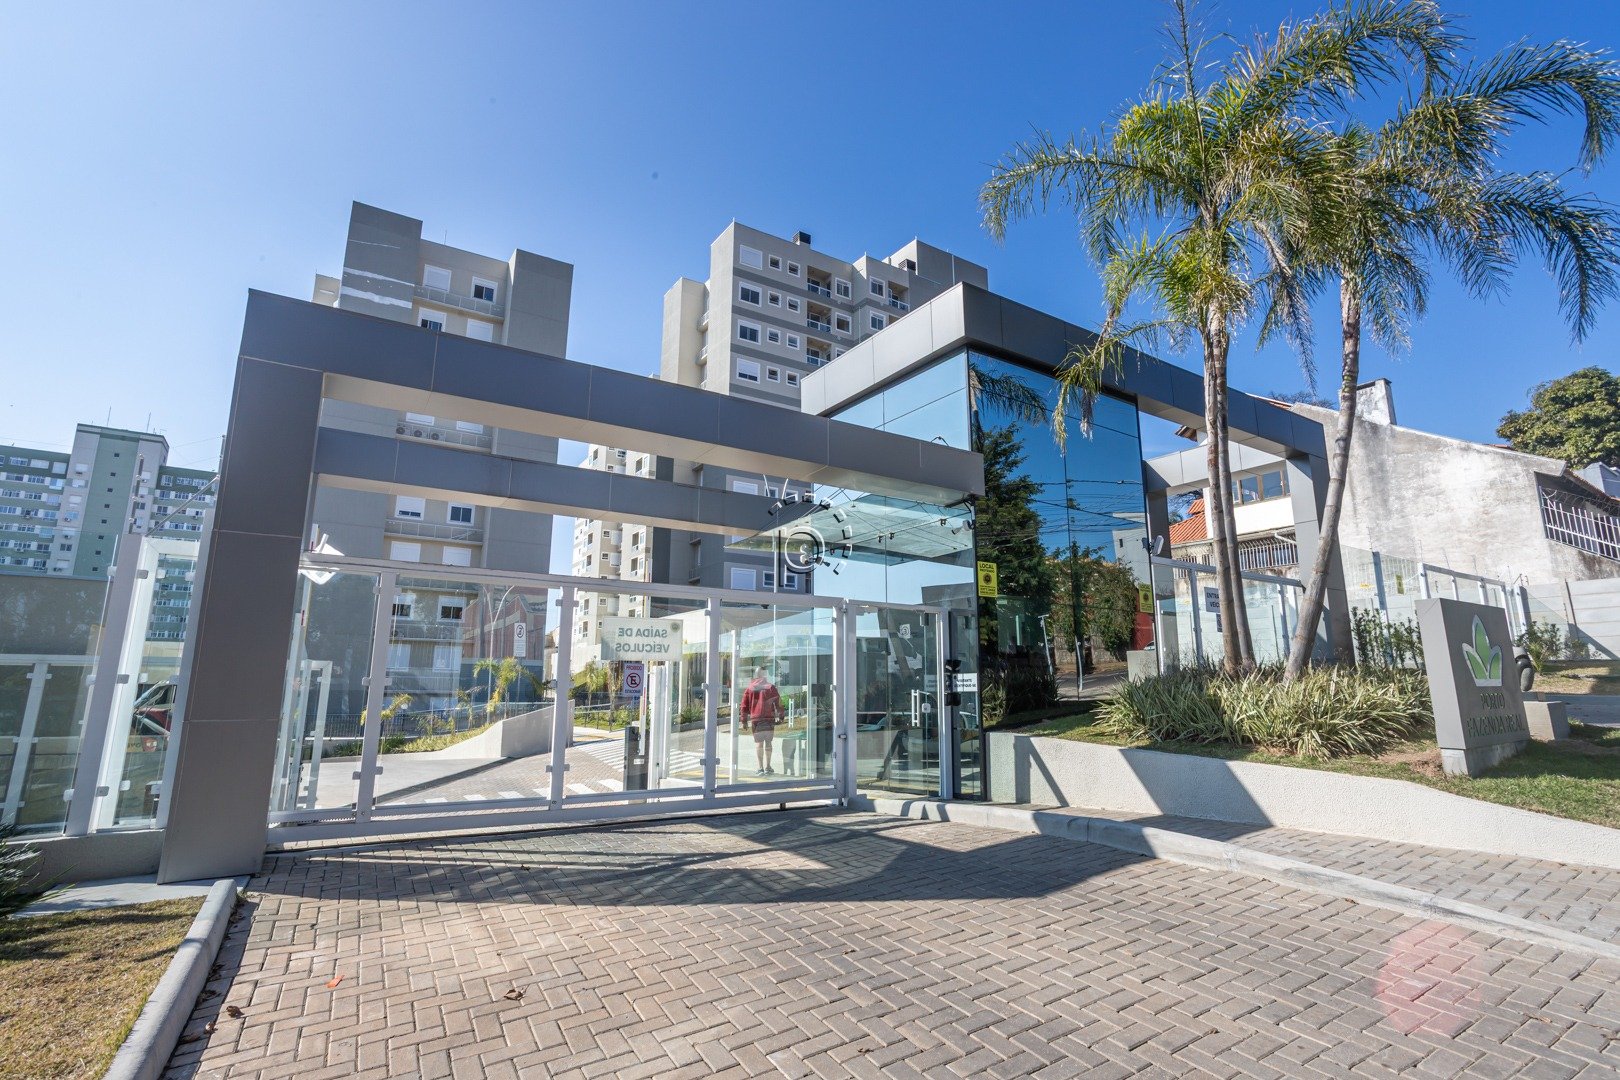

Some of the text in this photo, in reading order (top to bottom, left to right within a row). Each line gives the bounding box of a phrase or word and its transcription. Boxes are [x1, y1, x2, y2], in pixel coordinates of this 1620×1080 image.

[1480, 692, 1506, 710] PORTO
[1467, 713, 1525, 737] FAZENDA REAL
